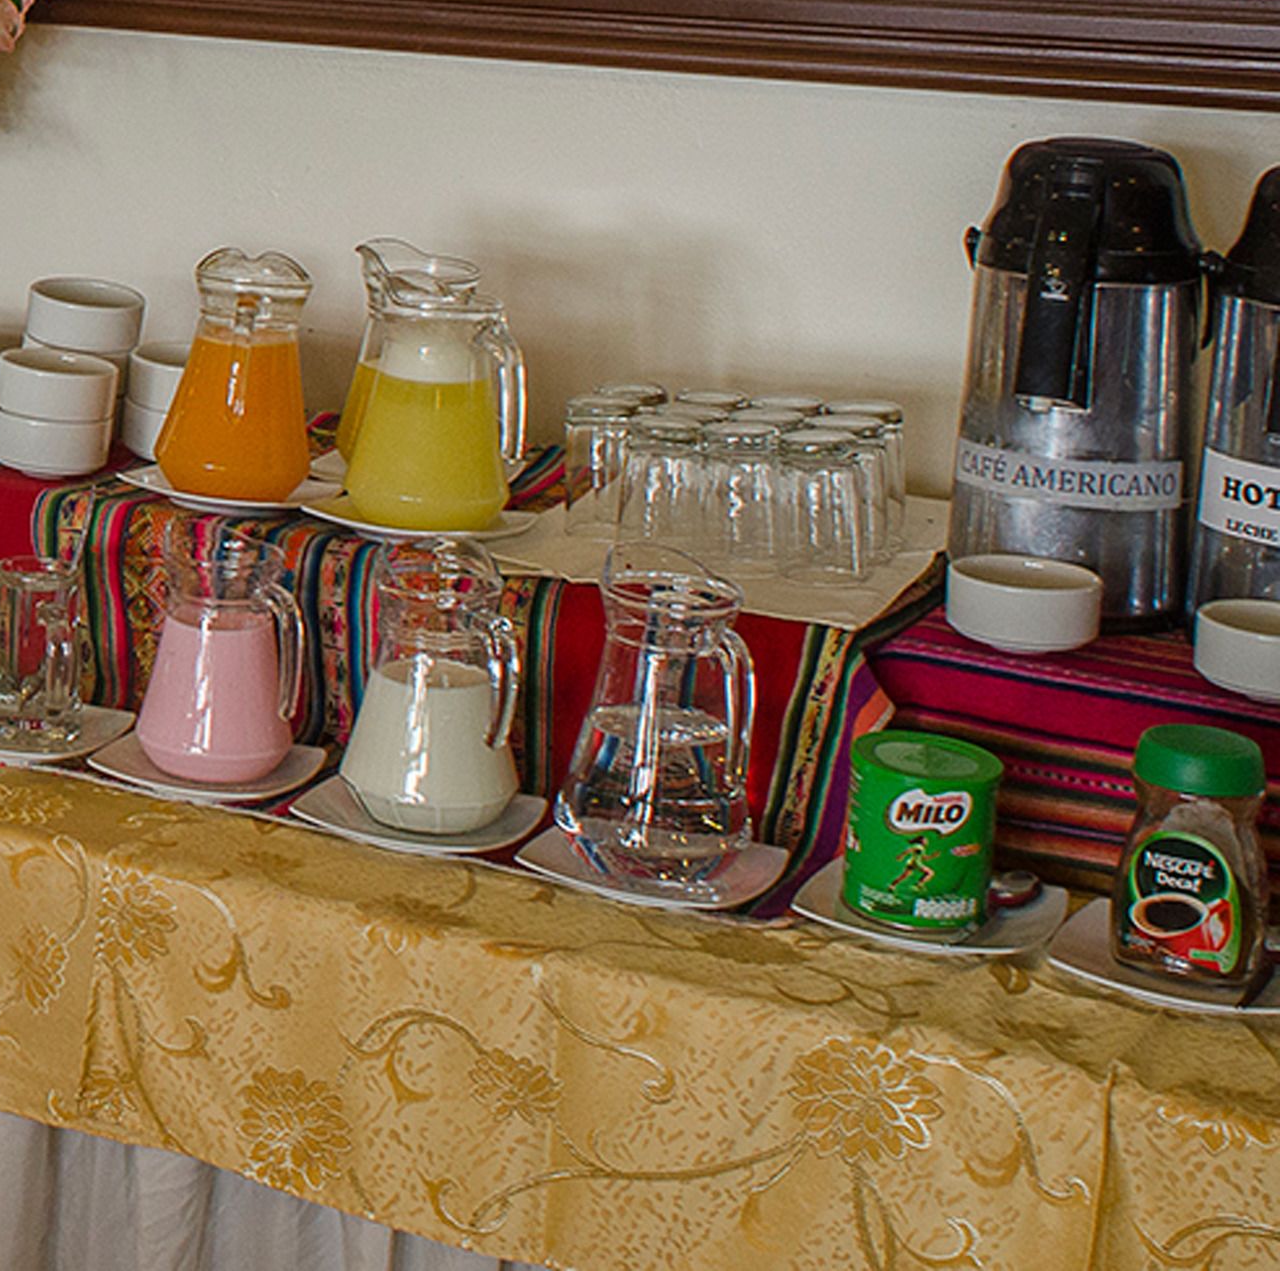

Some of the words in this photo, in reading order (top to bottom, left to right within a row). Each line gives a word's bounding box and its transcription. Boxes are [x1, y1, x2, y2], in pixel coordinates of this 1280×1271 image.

[960, 449, 1006, 483] CAFÉ
[1011, 464, 1177, 497] AMERICANO
[895, 801, 965, 824] MILO
[1156, 871, 1202, 892] Decaf
